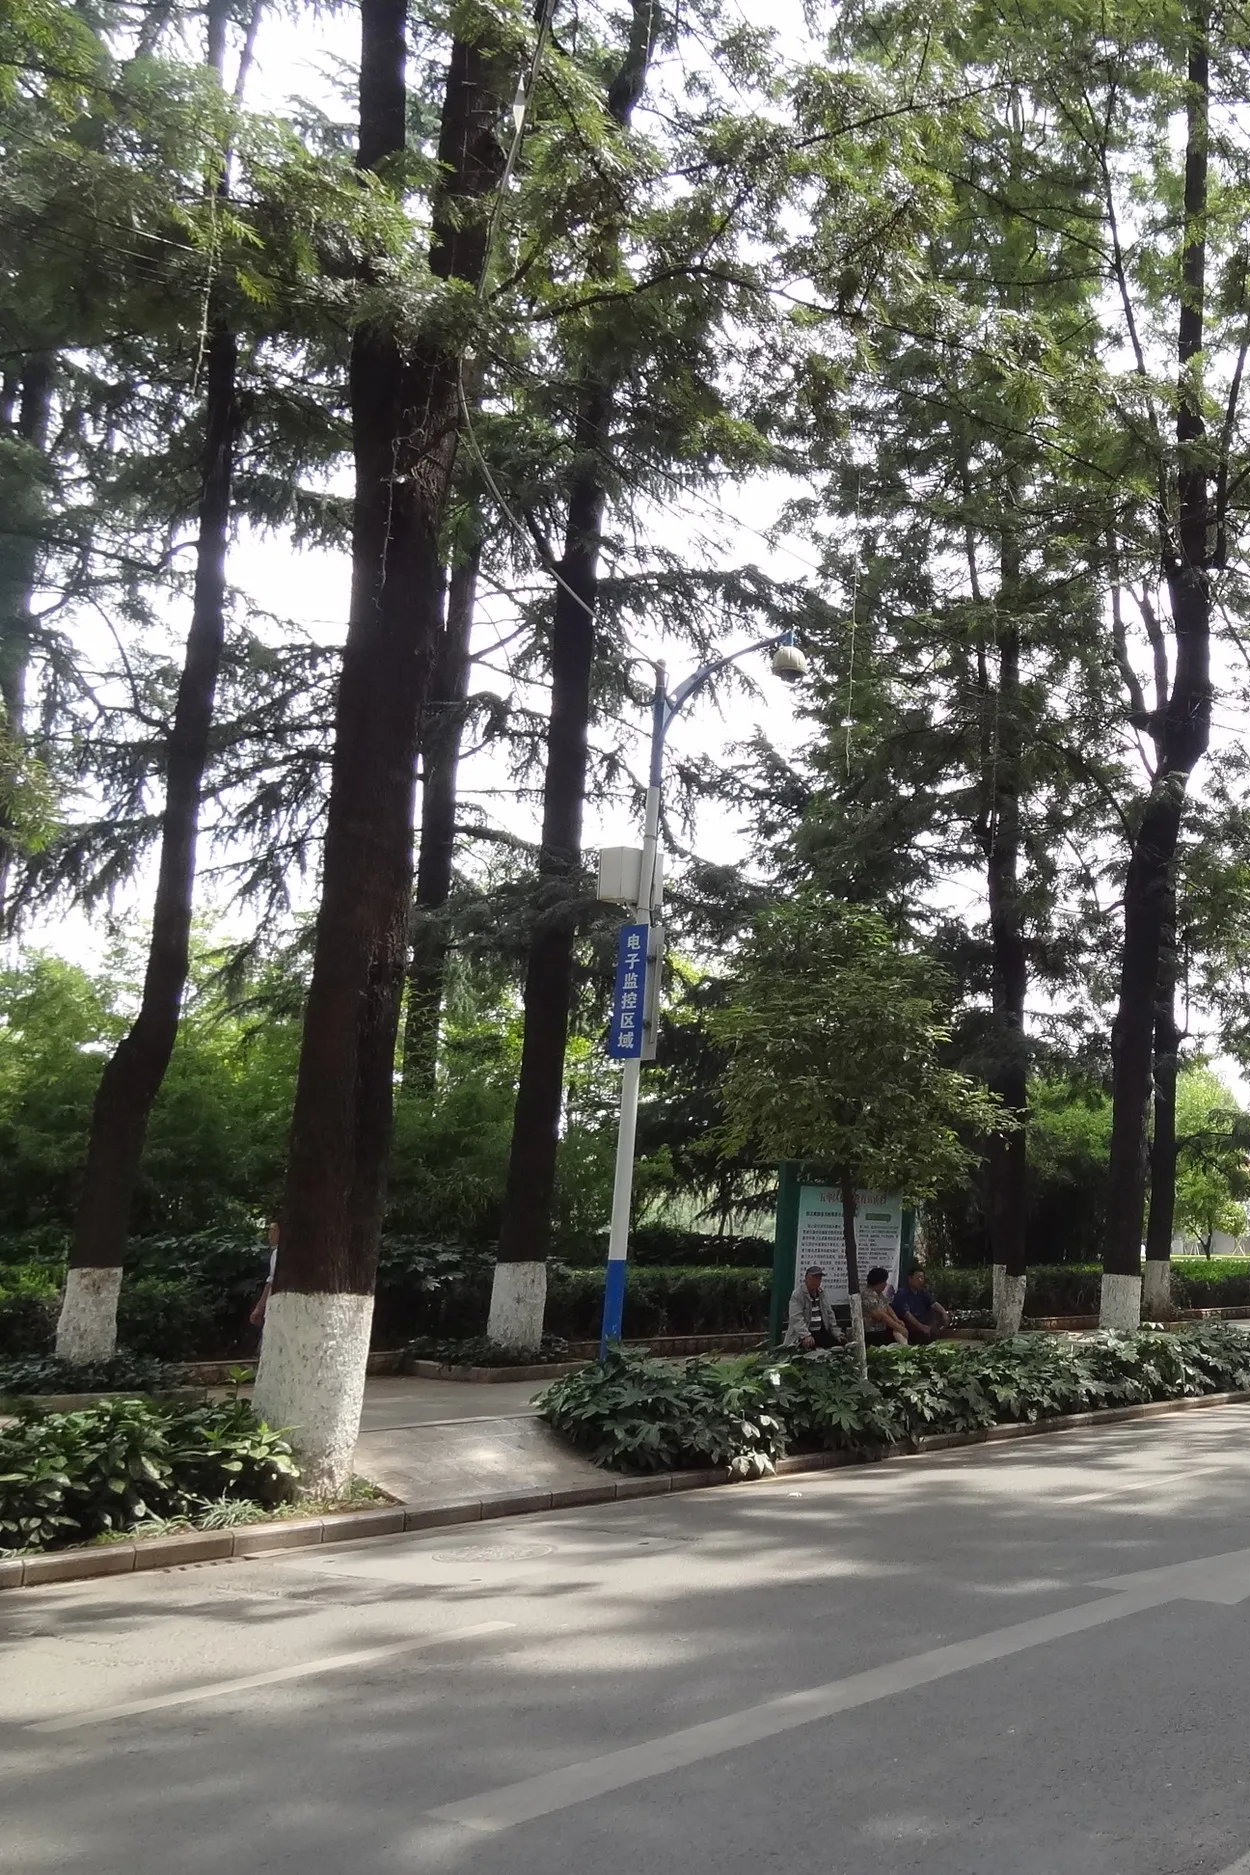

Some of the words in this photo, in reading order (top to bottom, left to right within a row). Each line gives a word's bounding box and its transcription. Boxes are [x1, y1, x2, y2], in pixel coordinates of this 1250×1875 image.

[617, 933, 641, 1049] 电子监控区域
